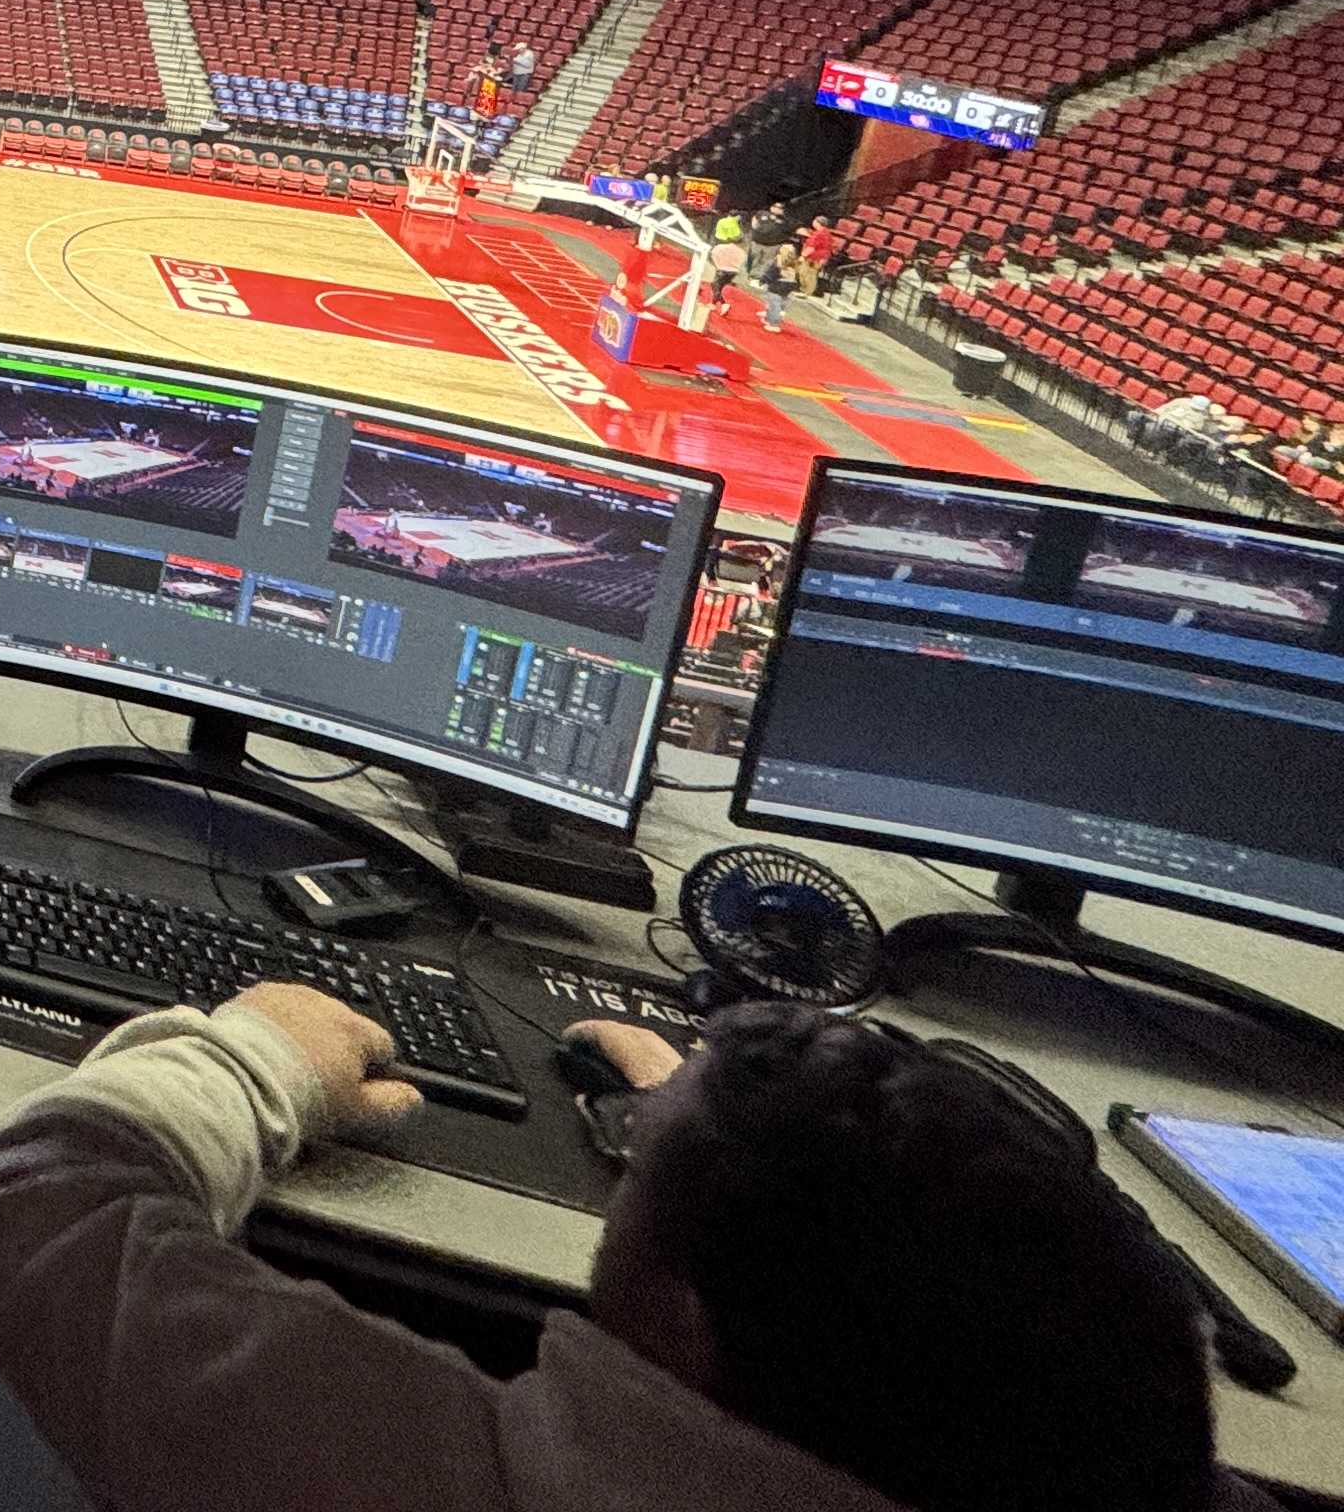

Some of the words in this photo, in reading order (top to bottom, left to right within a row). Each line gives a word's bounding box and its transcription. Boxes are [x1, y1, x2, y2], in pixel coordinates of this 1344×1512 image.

[875, 86, 887, 98] 0
[900, 90, 952, 115] 30:00
[965, 106, 978, 119] 0
[434, 277, 631, 413] HUSKERS
[542, 978, 578, 1002] IT
[587, 989, 629, 1014] IS
[640, 1000, 712, 1032] ABO
